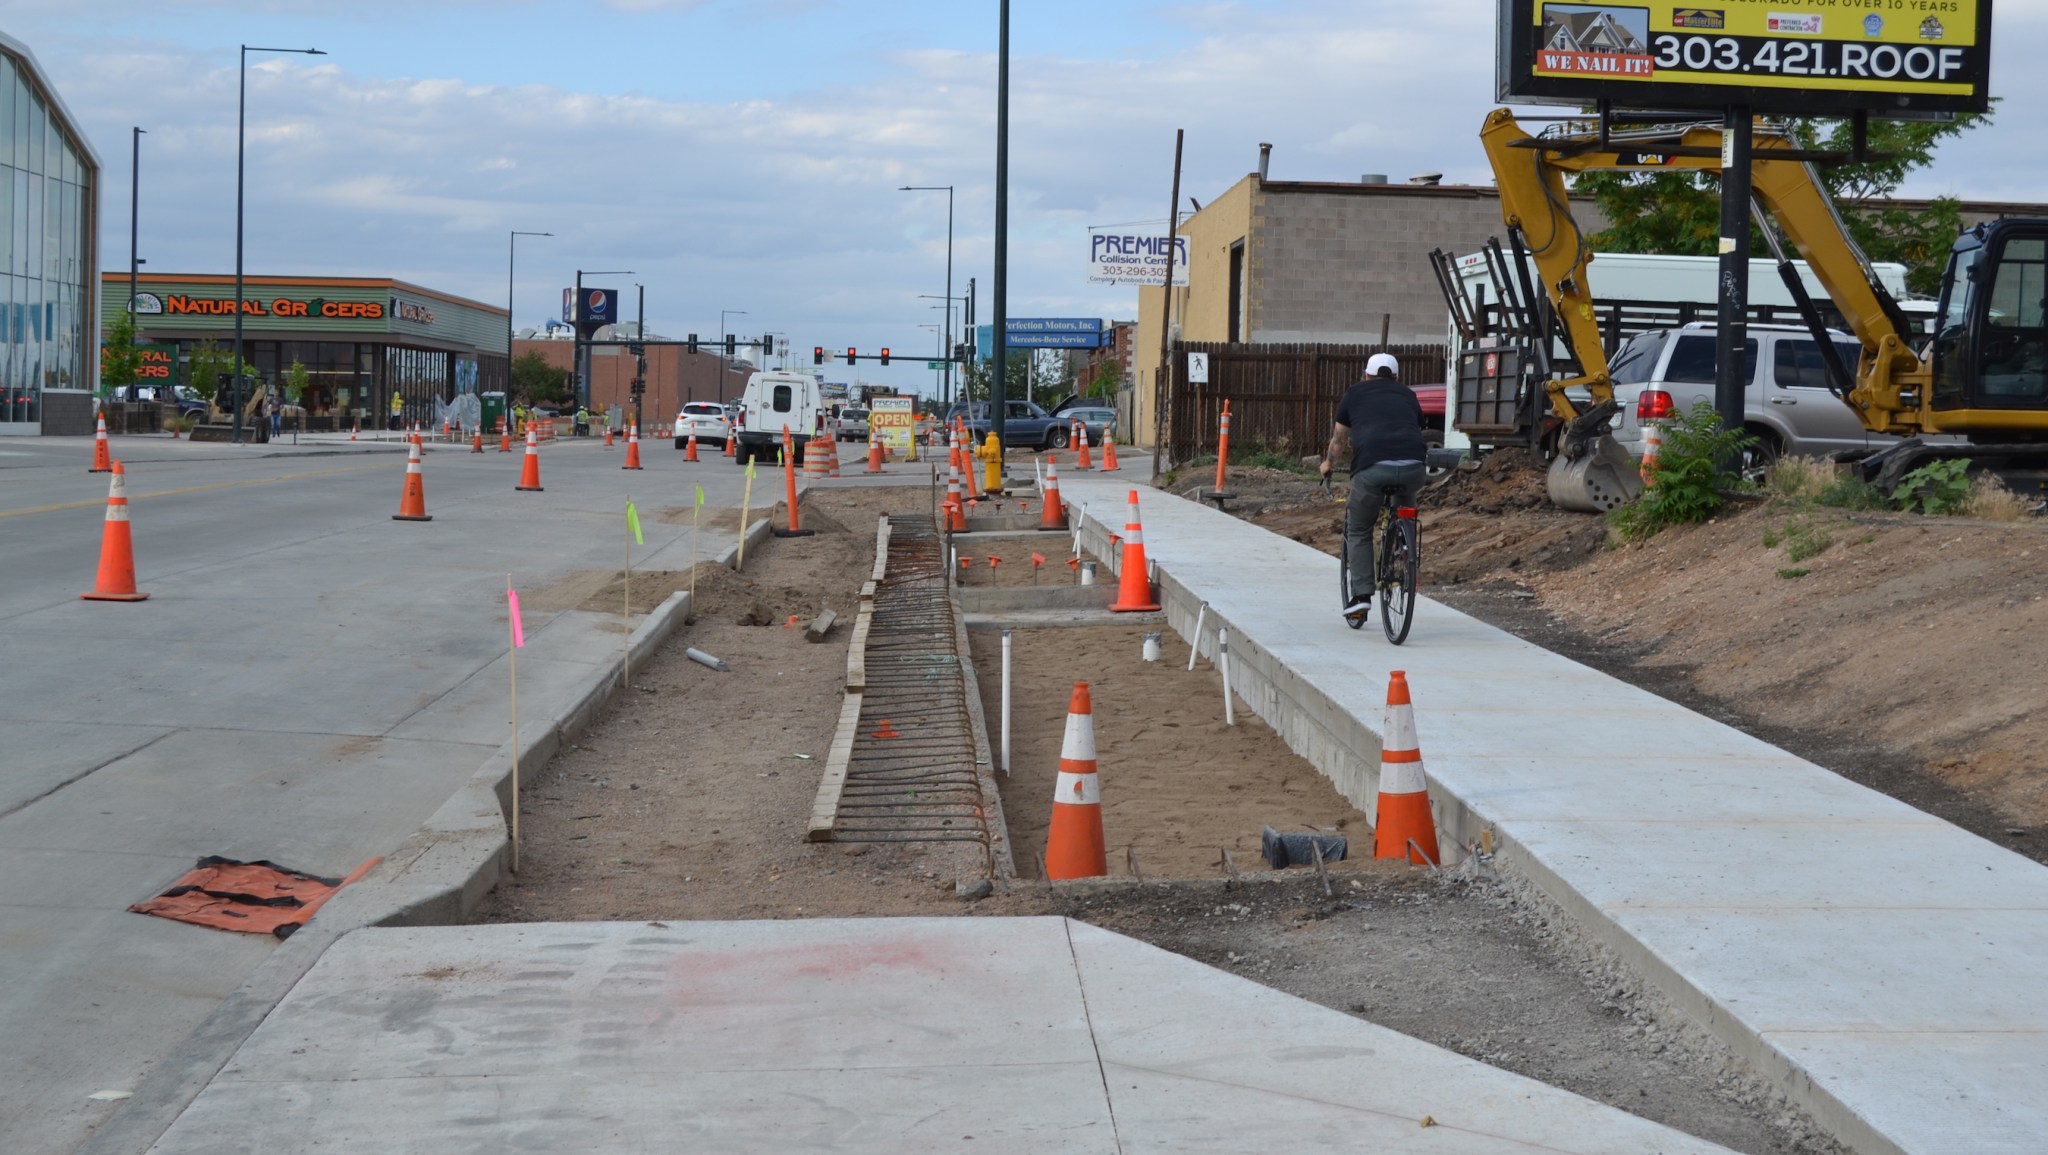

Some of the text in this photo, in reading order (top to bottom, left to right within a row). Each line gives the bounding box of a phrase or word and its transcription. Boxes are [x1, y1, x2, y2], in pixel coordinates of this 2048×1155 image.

[1842, 0, 1882, 9] OVER
[1910, 1, 1958, 12] YEARS
[1653, 34, 1963, 80] 303.421.ROOF
[1544, 54, 1650, 74] WE NAIL IT!
[1091, 234, 1187, 266] PREMIER
[1099, 254, 1179, 265] Collision Centr
[1102, 265, 1174, 278] 303-296-303
[1117, 276, 1146, 285] Autobody
[167, 295, 266, 315] NATURAL
[1006, 320, 1095, 330] erfection Motors, Inc.
[1010, 335, 1087, 344] Mercedes-Benz Service
[874, 413, 910, 426] OPEN
